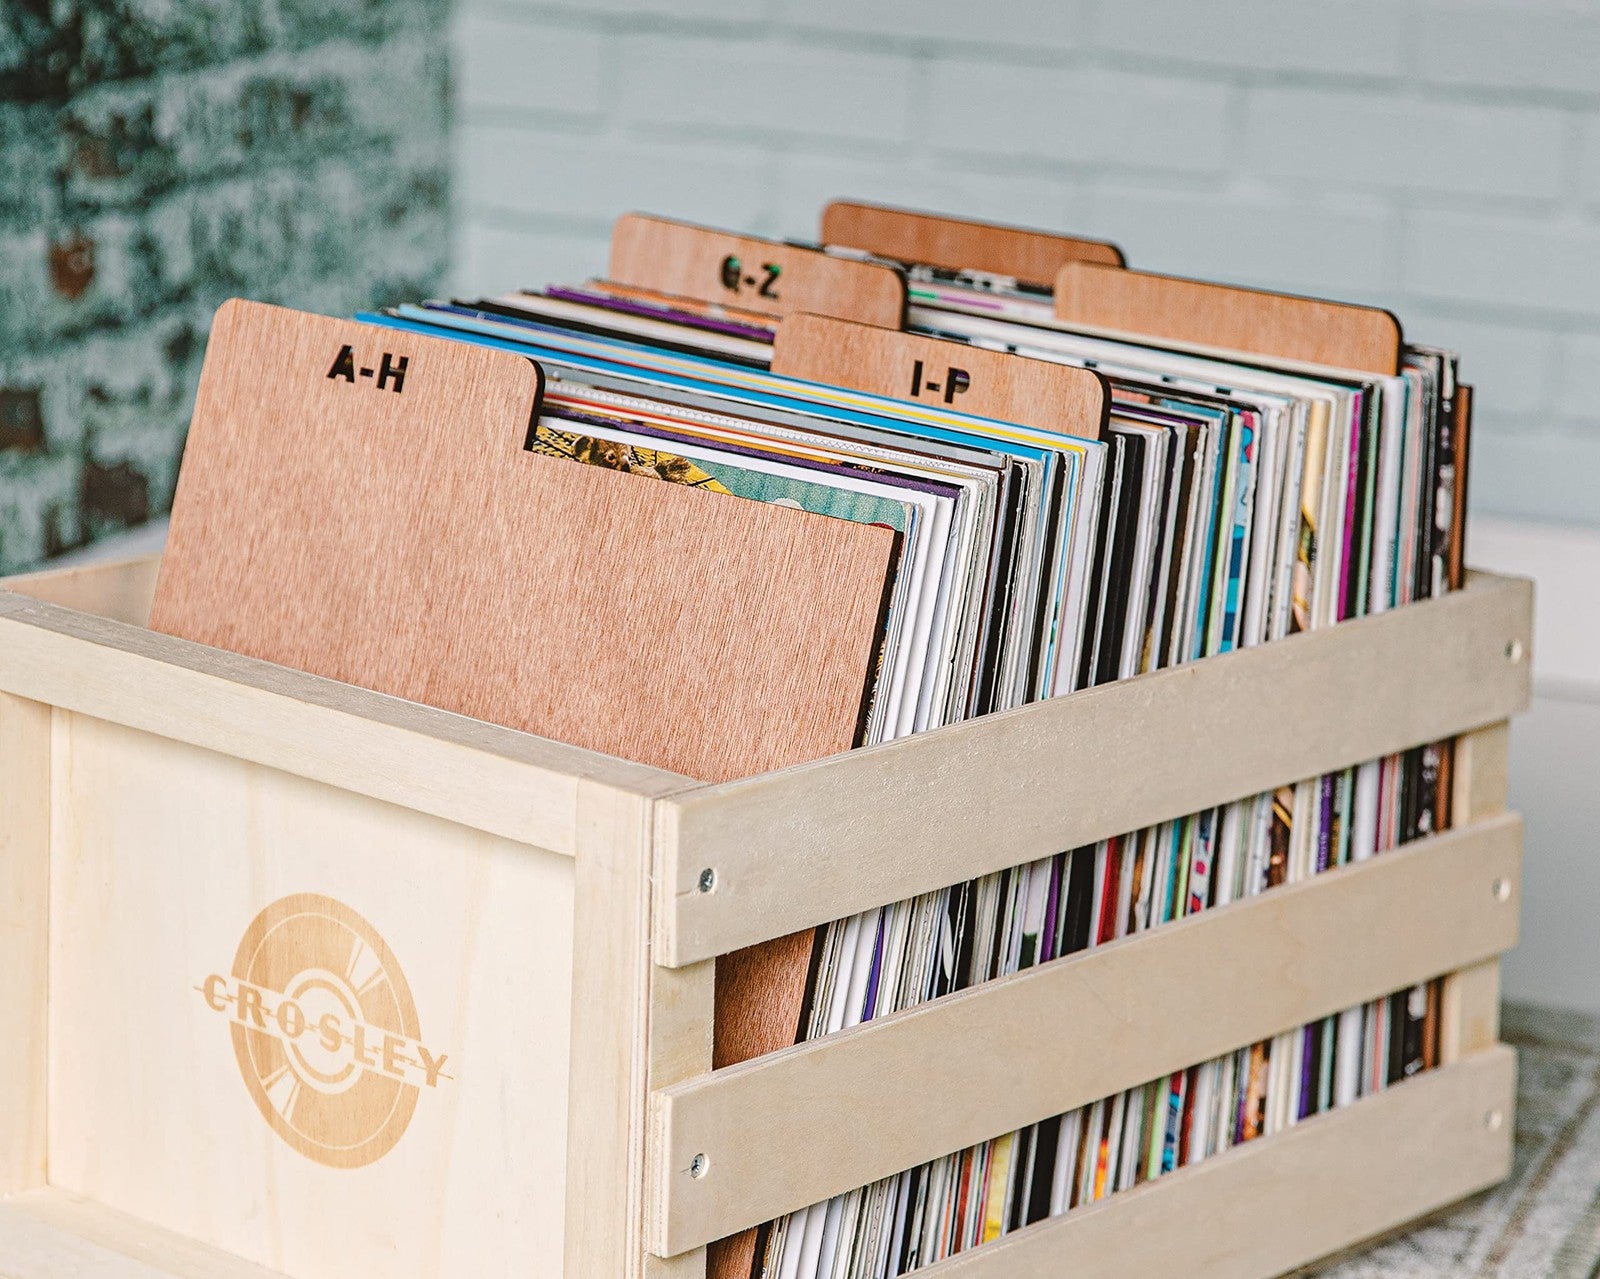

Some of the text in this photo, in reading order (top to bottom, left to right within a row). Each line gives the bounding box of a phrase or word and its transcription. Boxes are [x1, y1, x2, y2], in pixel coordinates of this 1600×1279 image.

[720, 255, 781, 299] Q-Z
[327, 345, 409, 393] A-H
[910, 360, 971, 404] I-P
[201, 973, 450, 1088] CROSLEY
